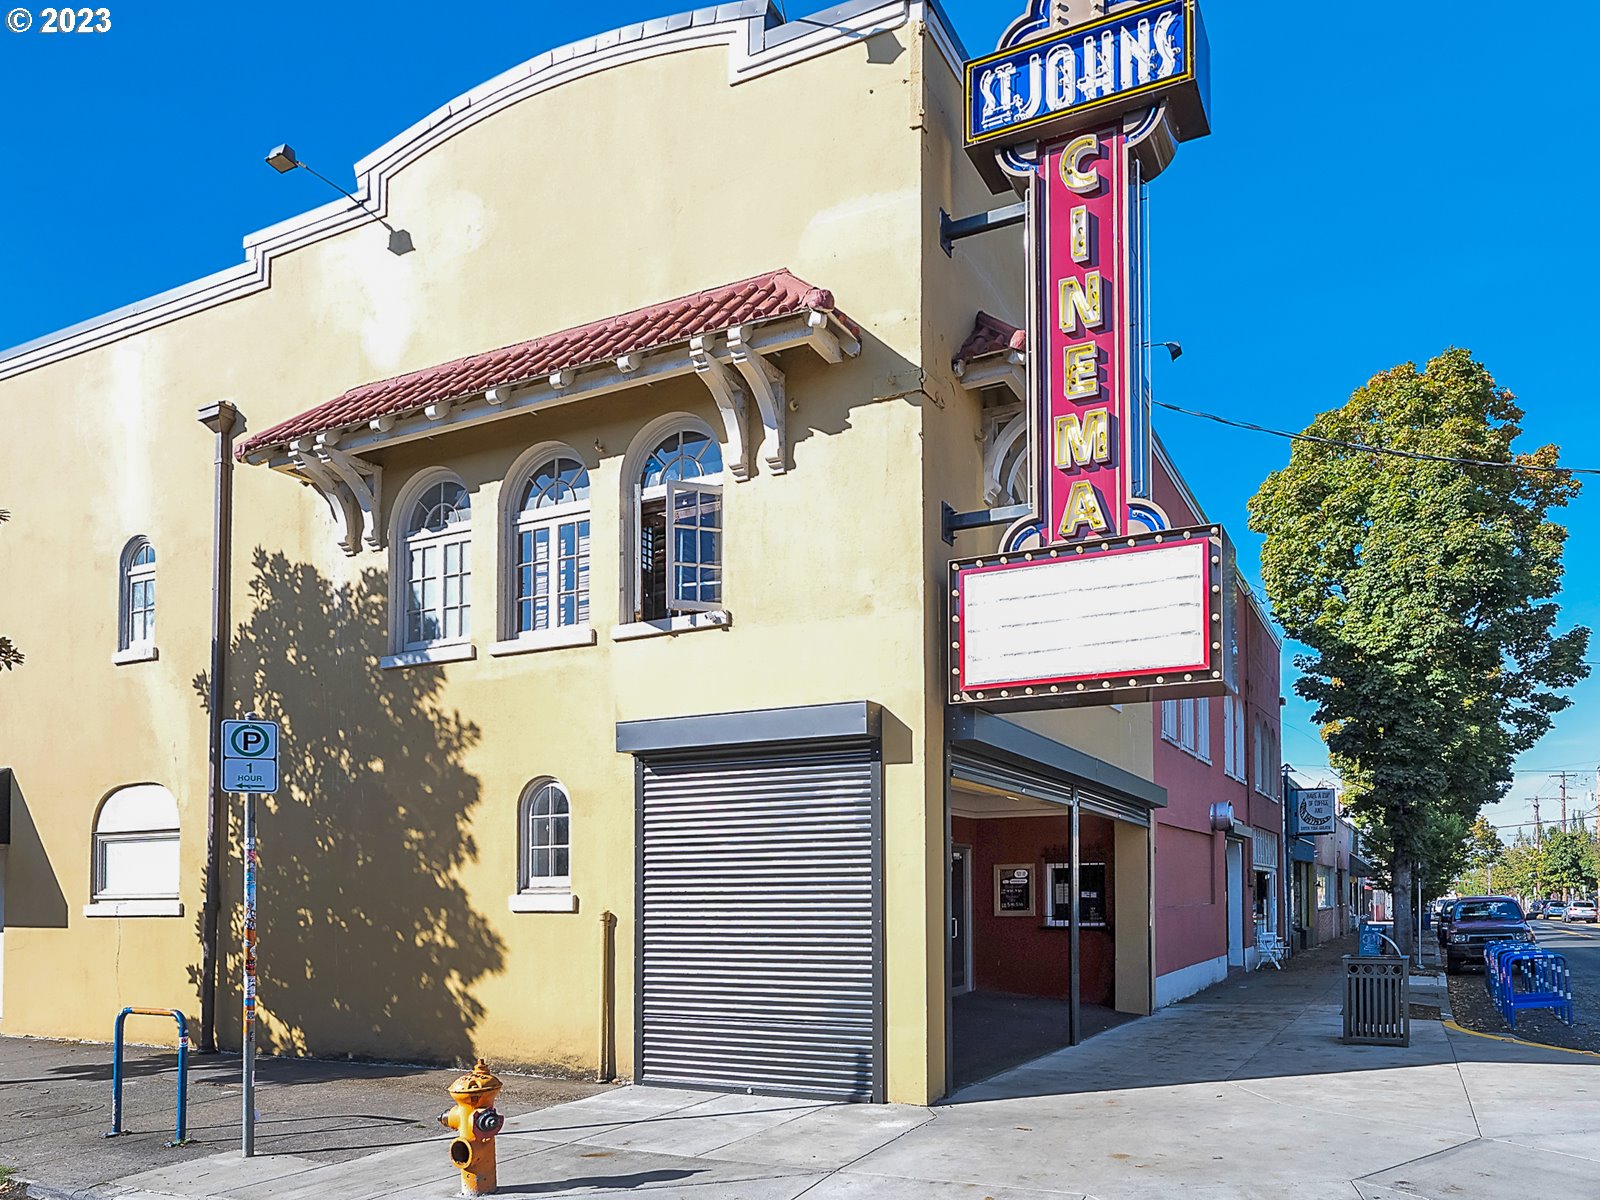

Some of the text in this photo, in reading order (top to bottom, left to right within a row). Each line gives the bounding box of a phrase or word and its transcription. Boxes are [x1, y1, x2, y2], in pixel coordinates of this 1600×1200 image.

[1014, 10, 1179, 122] JOHNS
[1054, 134, 1111, 536] CINEMA
[243, 731, 262, 750] P
[246, 763, 252, 773] 1
